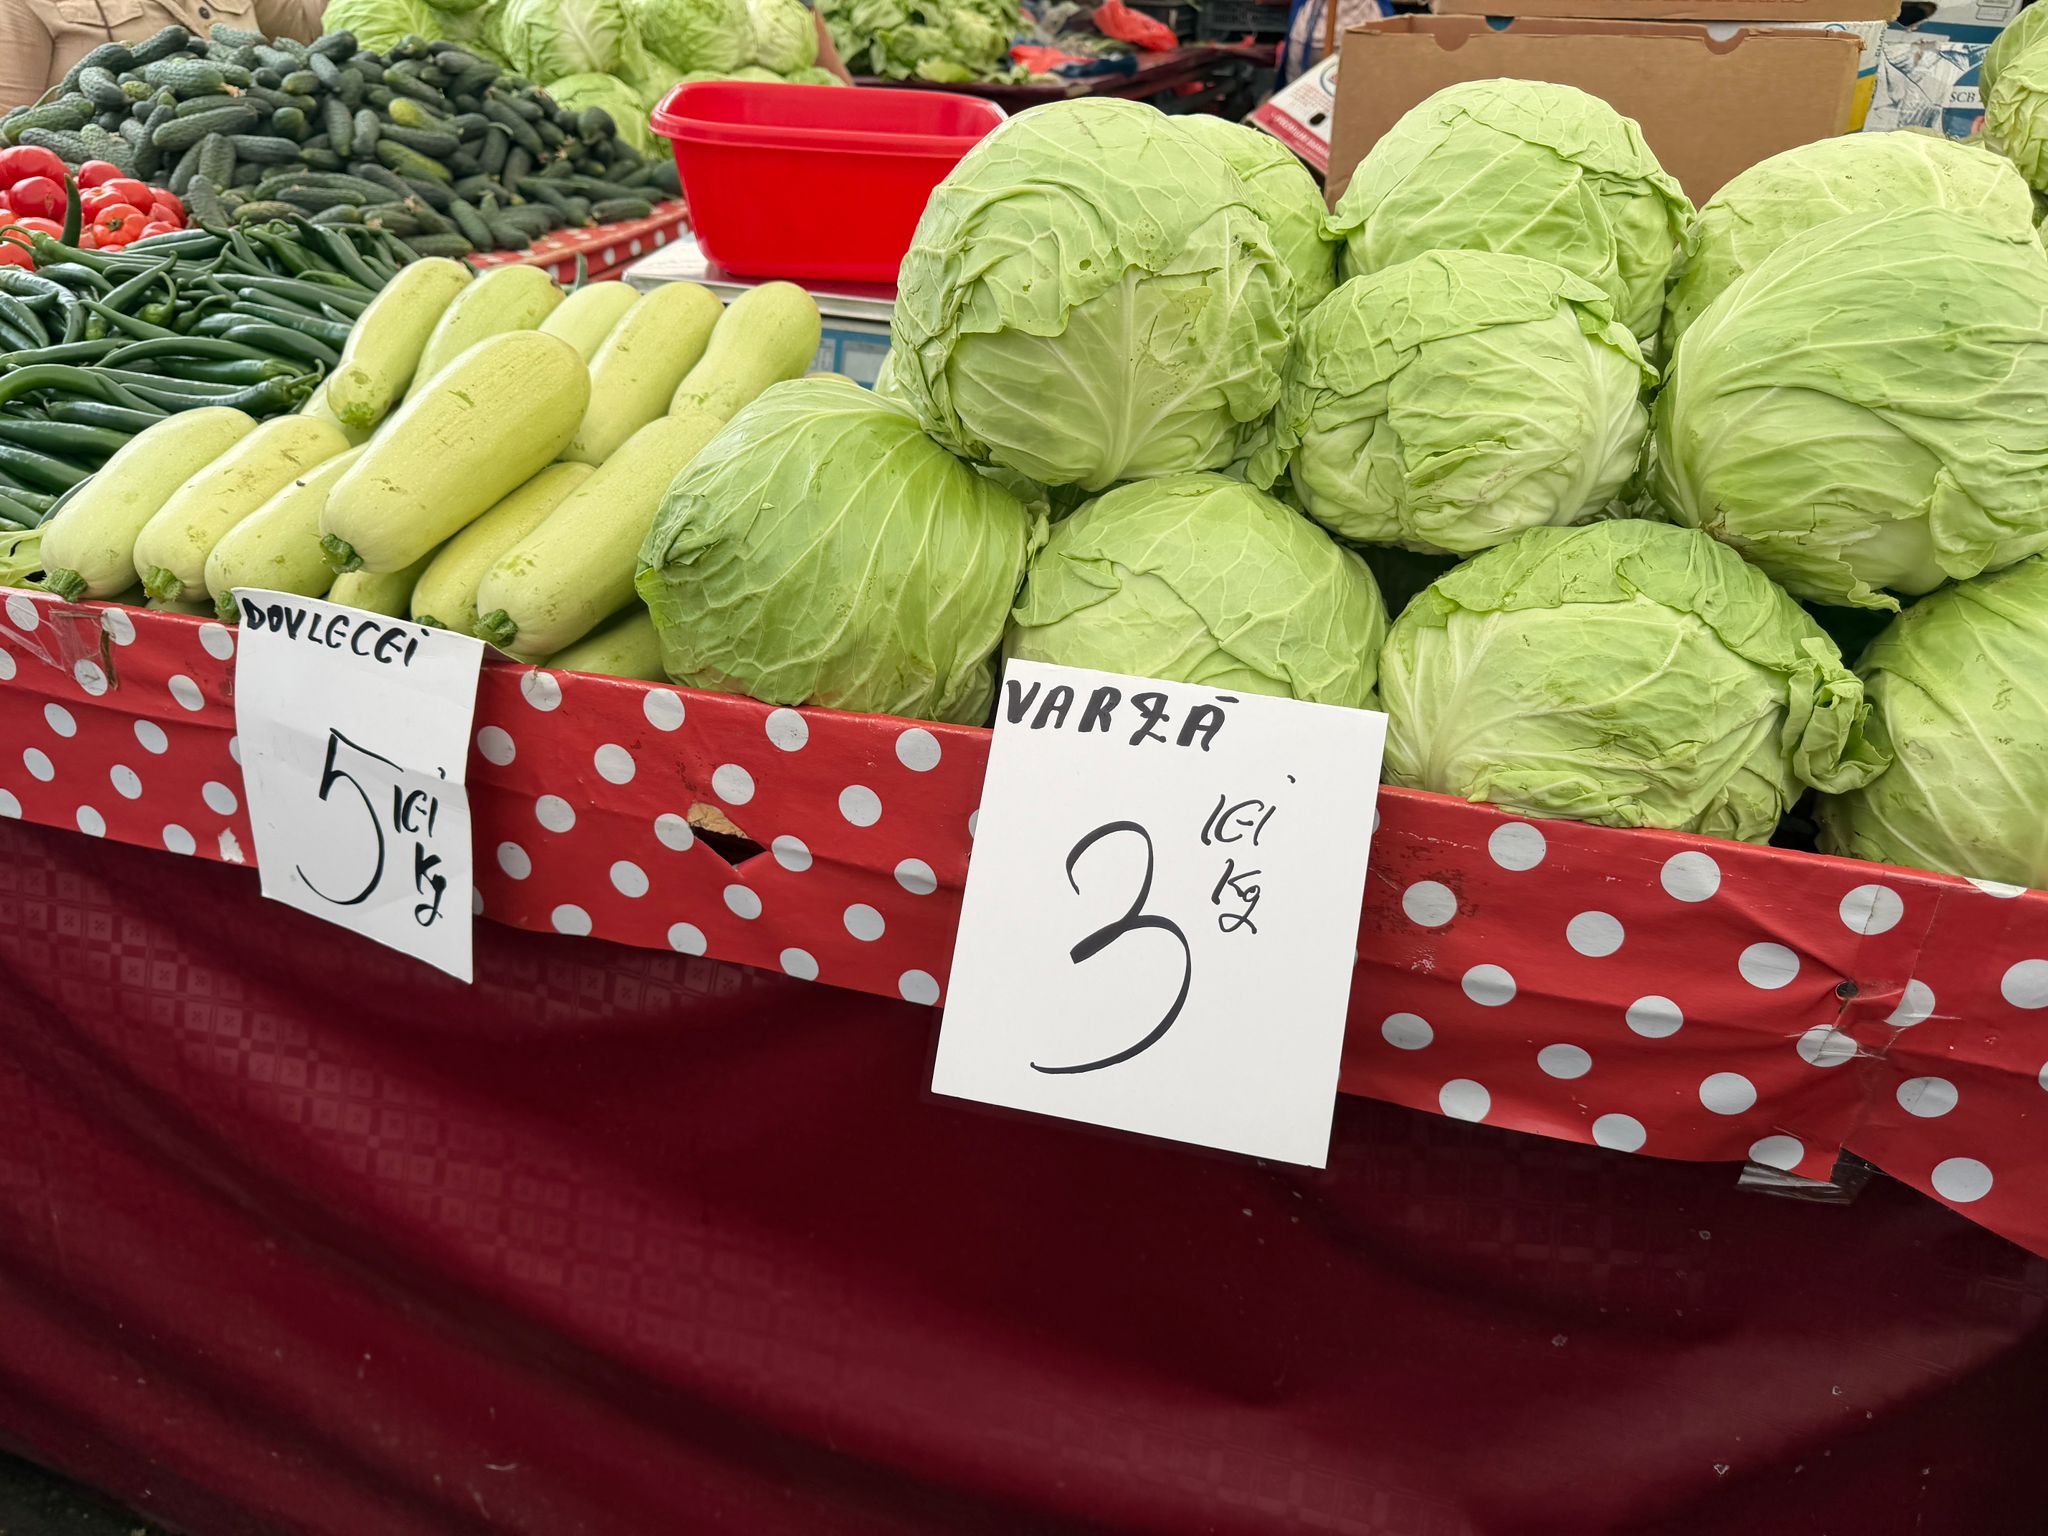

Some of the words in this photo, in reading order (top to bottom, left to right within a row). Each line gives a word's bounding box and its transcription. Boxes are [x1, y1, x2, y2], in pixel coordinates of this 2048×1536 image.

[1949, 91, 1975, 103] SCB
[296, 727, 404, 906] 5
[1030, 820, 1192, 1074] 3
